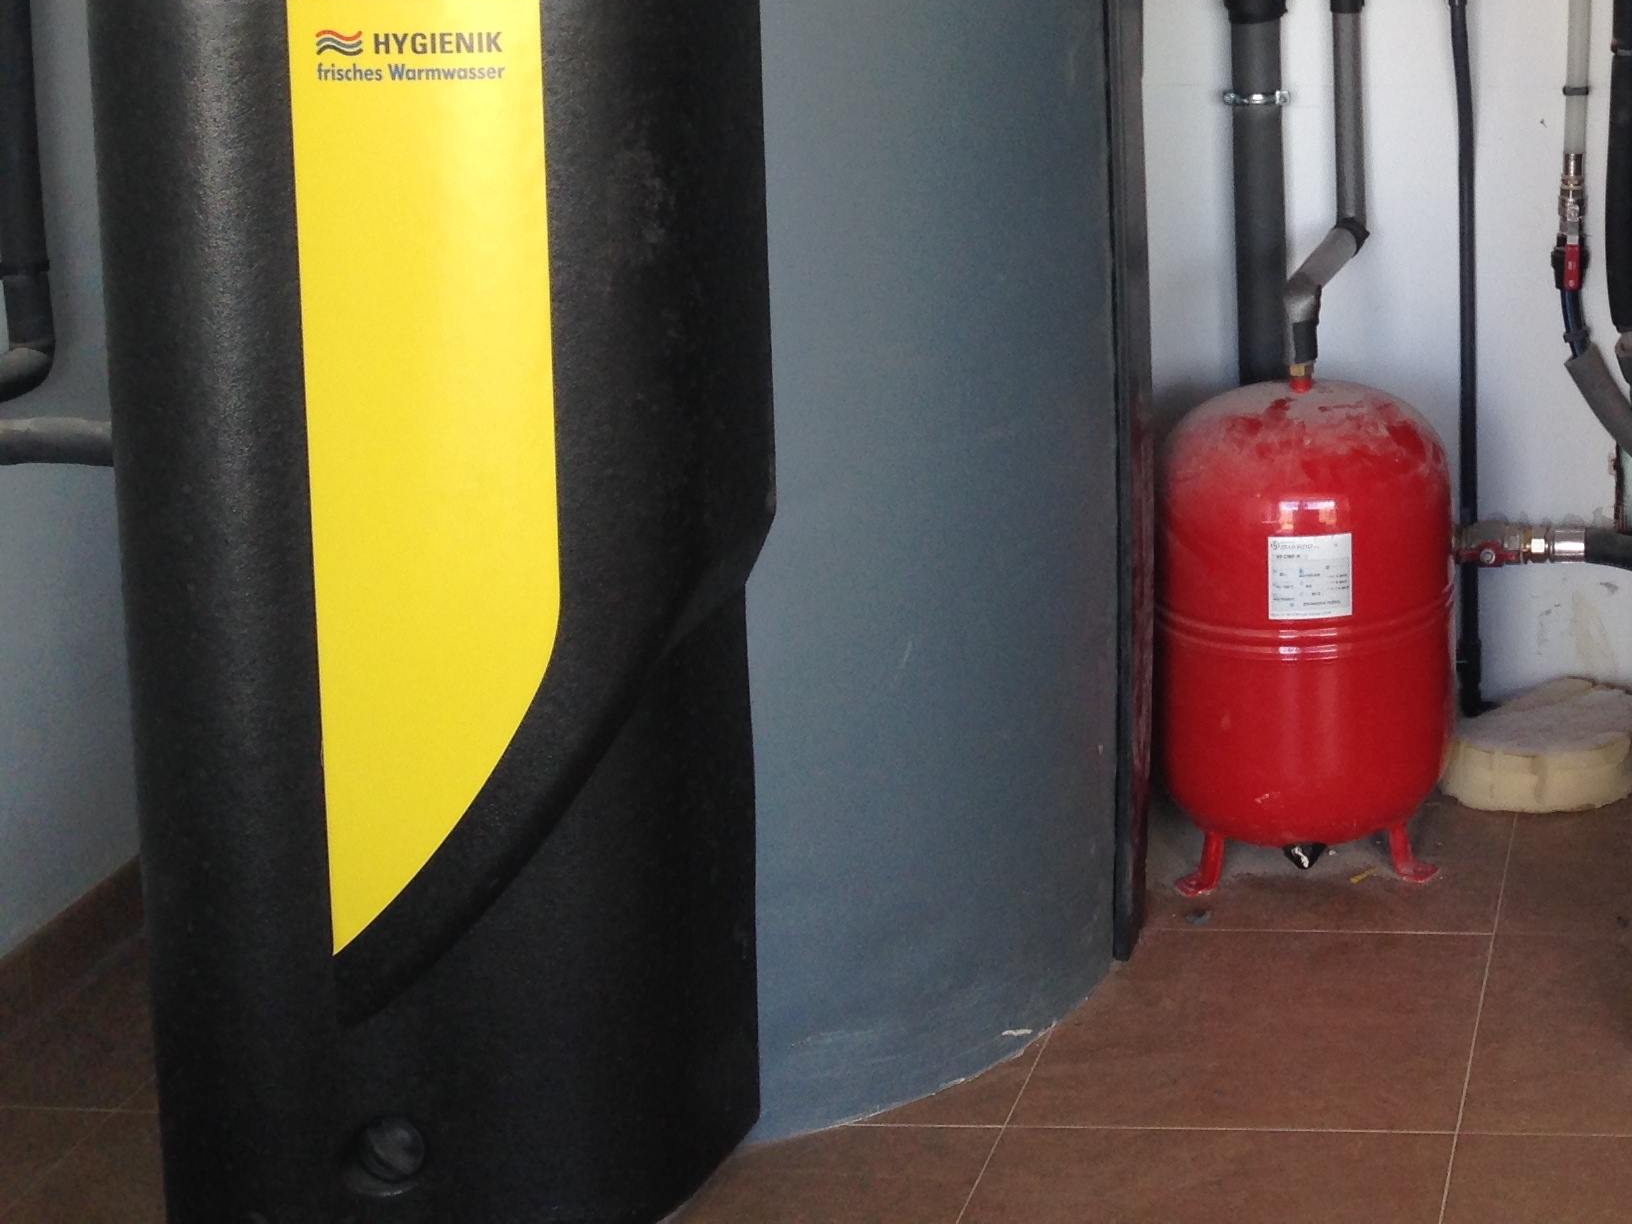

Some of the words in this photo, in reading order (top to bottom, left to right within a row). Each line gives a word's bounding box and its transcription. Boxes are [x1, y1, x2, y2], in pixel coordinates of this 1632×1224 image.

[373, 31, 503, 55] HYGIENIK
[317, 62, 383, 81] frisches
[388, 62, 506, 80] Warmwasser
